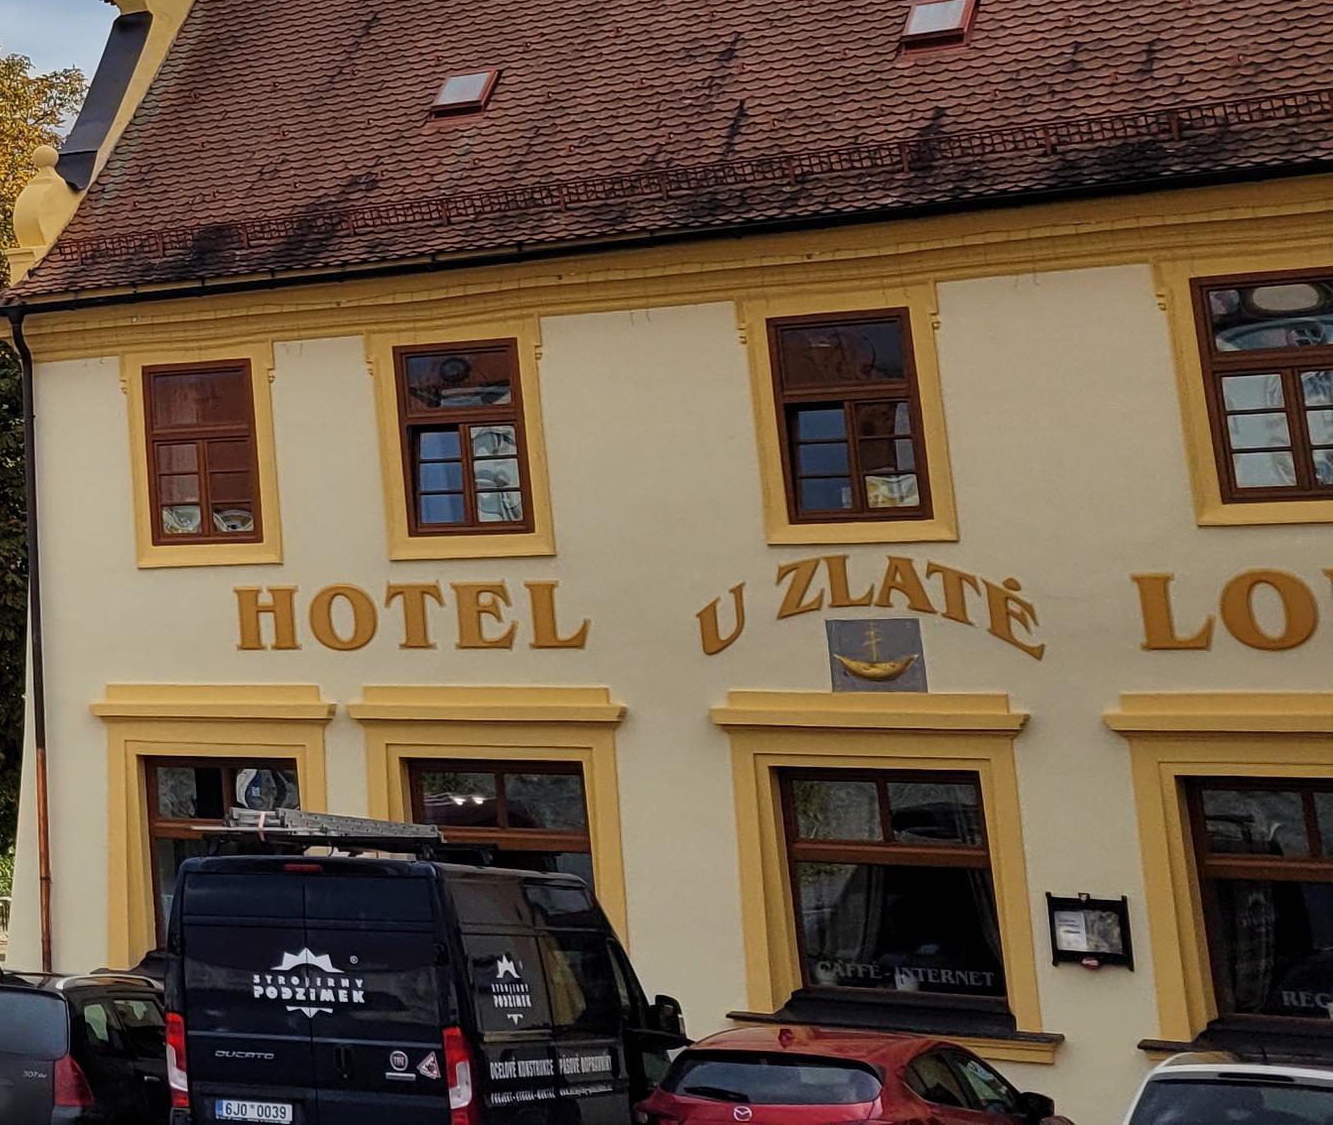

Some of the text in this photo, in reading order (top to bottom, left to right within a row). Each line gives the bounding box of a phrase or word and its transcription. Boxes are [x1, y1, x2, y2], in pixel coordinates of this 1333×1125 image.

[234, 579, 591, 651] HOTEL
[695, 554, 1333, 661] U ZLATÉ LO
[253, 985, 365, 1003] PODZIMEK
[215, 1050, 274, 1059] DUCATO
[257, 1105, 286, 1119] 0039
